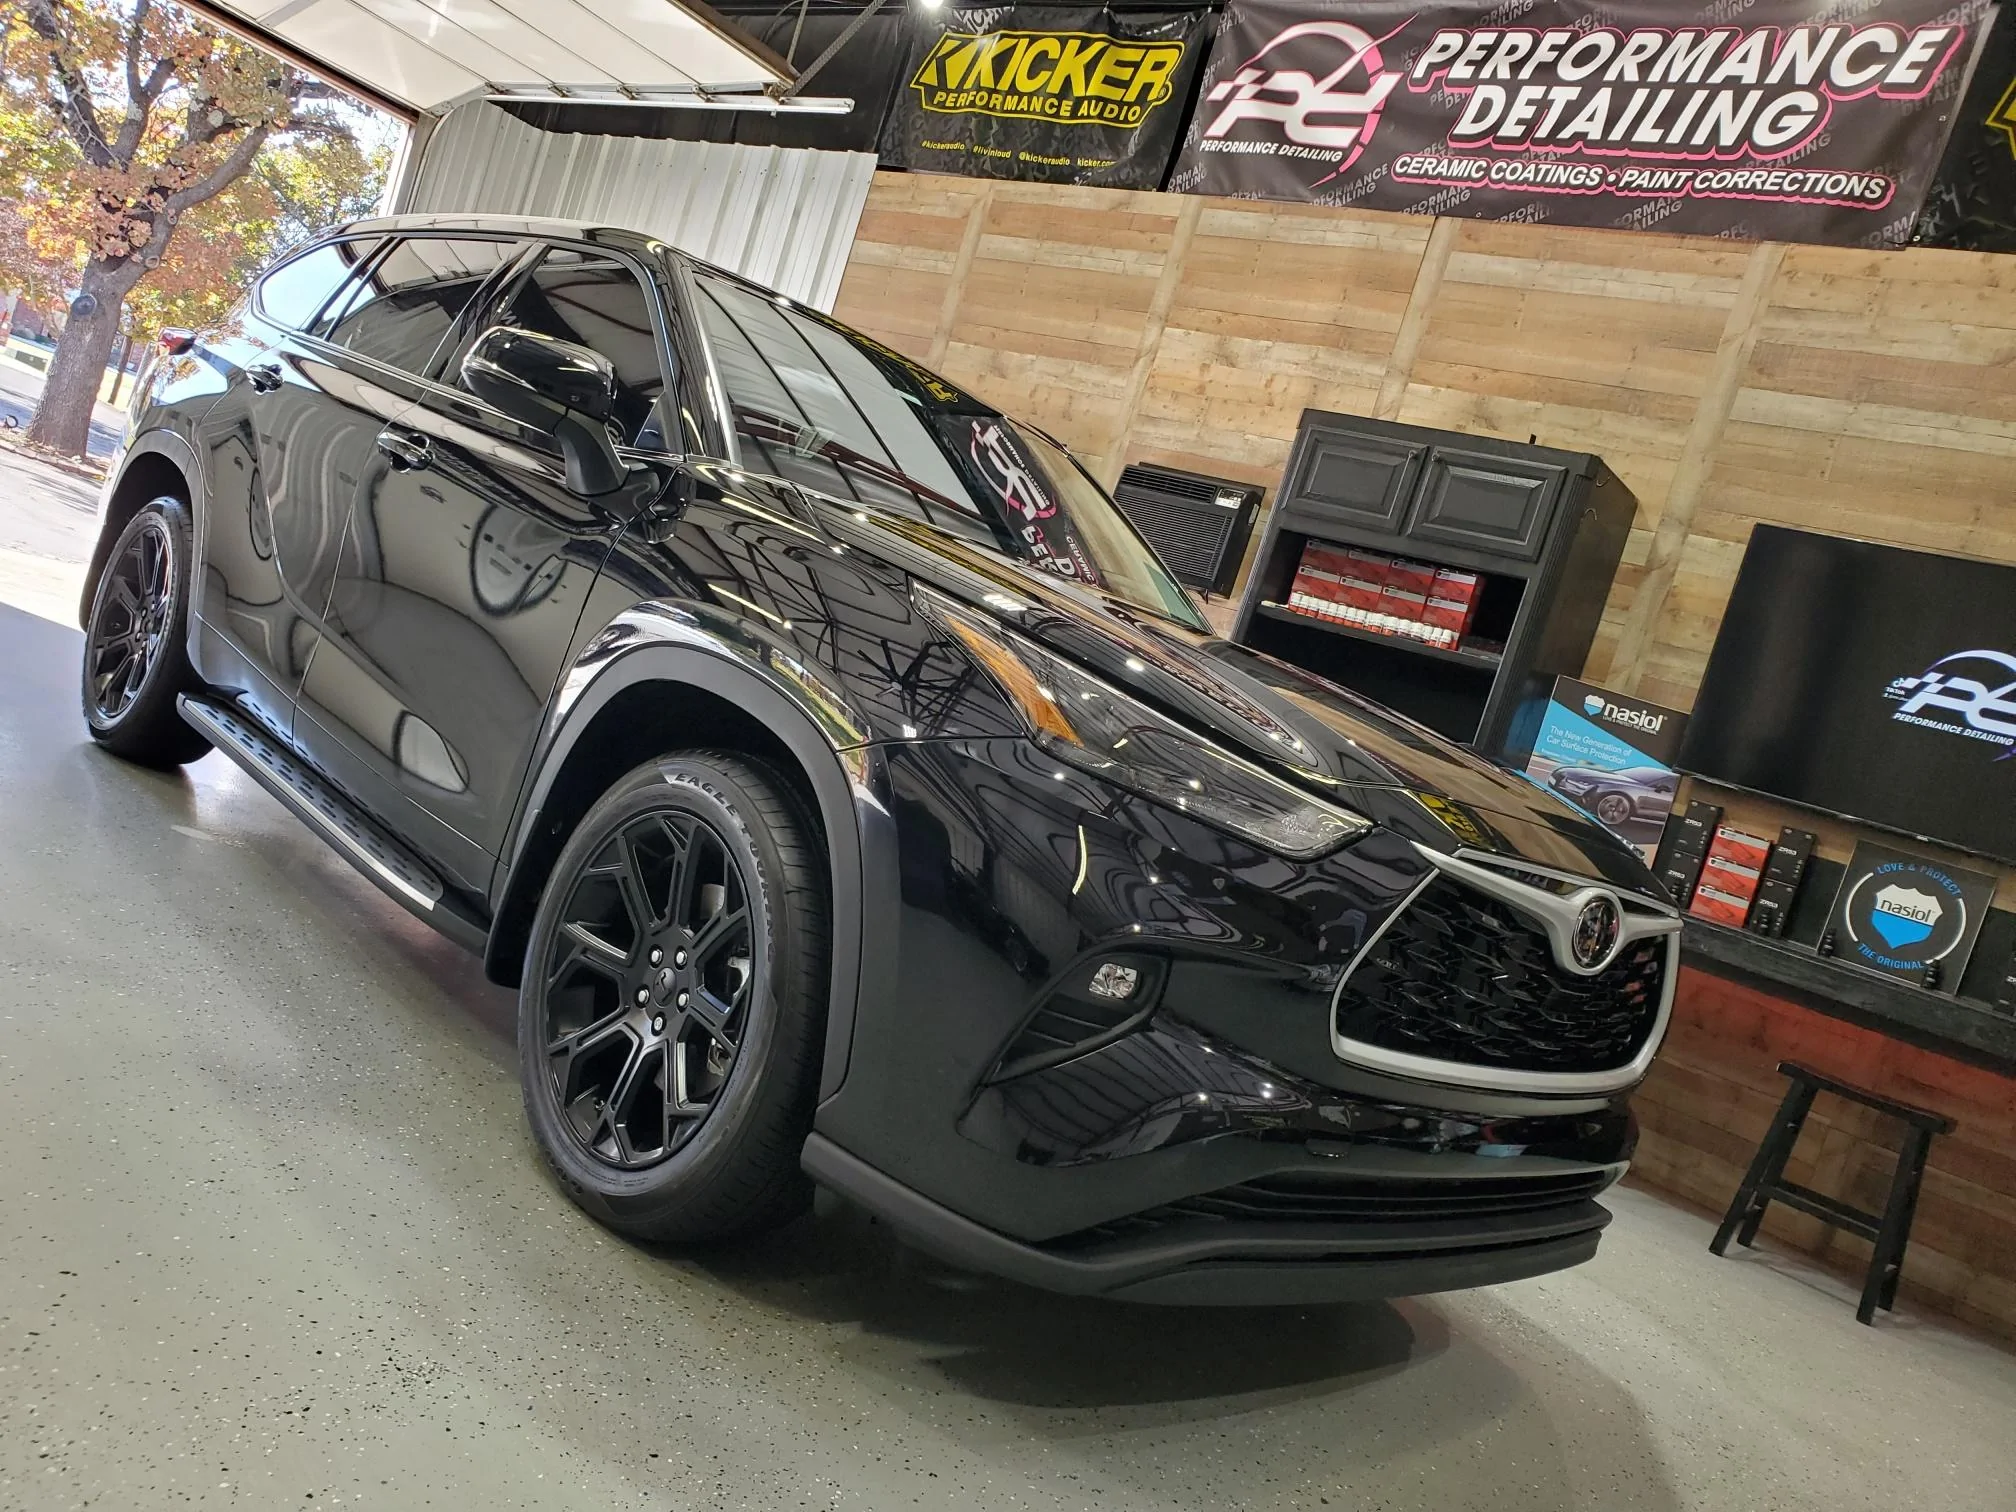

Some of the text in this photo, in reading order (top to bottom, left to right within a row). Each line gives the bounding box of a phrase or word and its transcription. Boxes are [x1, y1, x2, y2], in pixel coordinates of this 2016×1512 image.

[1412, 27, 1949, 87] PERFORMANCE
[933, 90, 1141, 121] PERFORMANCE AUDIO
[1452, 85, 1818, 147] DETAILING
[1018, 152, 1071, 166] @kickeraudio
[1199, 139, 1343, 162] PERFORMANCE DETAILING
[1395, 155, 1486, 178] CERAMIC
[1490, 161, 1603, 186] COATINGS
[1619, 169, 1693, 189] PAINT
[1694, 171, 1886, 199] CORRECTIONS
[1603, 703, 1664, 731] nasiol
[1891, 712, 2015, 746] PERFORMANCE DETAILING
[1546, 735, 1560, 745] Car
[1560, 739, 1589, 754] Surface
[1589, 747, 1626, 765] Protection
[1551, 725, 1632, 757] The New Generation of
[674, 773, 740, 817] EAGLE
[1877, 862, 1963, 897] LOVE & PROTECT
[1880, 899, 1932, 922] nasiol
[1857, 943, 1925, 969] THE ORIGINAL
